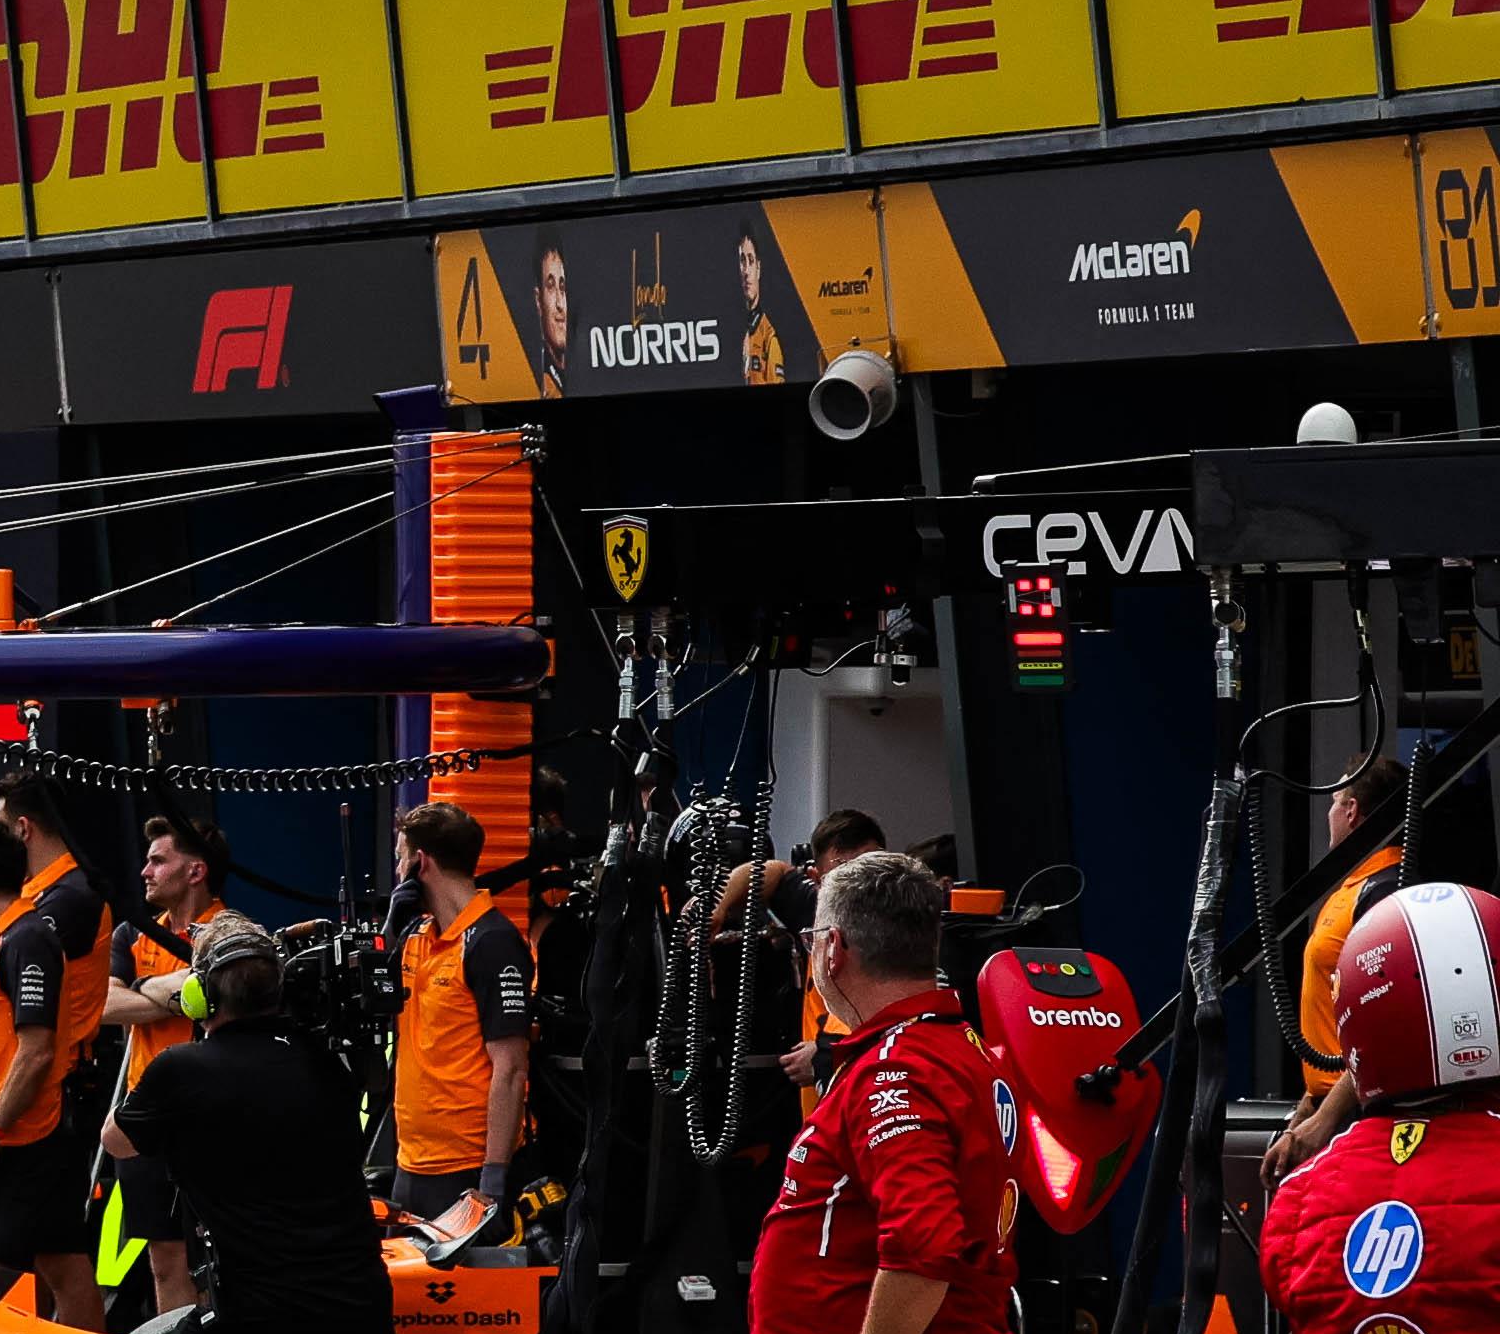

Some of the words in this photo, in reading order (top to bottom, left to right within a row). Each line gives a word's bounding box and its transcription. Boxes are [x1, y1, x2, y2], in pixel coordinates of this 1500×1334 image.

[1069, 235, 1190, 282] McLaren
[819, 278, 869, 298] McLaren
[456, 254, 491, 382] 4
[1098, 305, 1148, 327] FORMULA
[1153, 305, 1161, 325] 1
[1165, 302, 1196, 323] TEAM
[590, 319, 720, 368] NORRIS
[1356, 943, 1392, 966] PERONI
[1029, 1005, 1122, 1029] brembo
[1455, 1023, 1478, 1035] DOT
[1454, 1051, 1487, 1063] BELL
[876, 1071, 909, 1083] aws
[1353, 1205, 1415, 1295] hp
[463, 1309, 521, 1326] Dash
